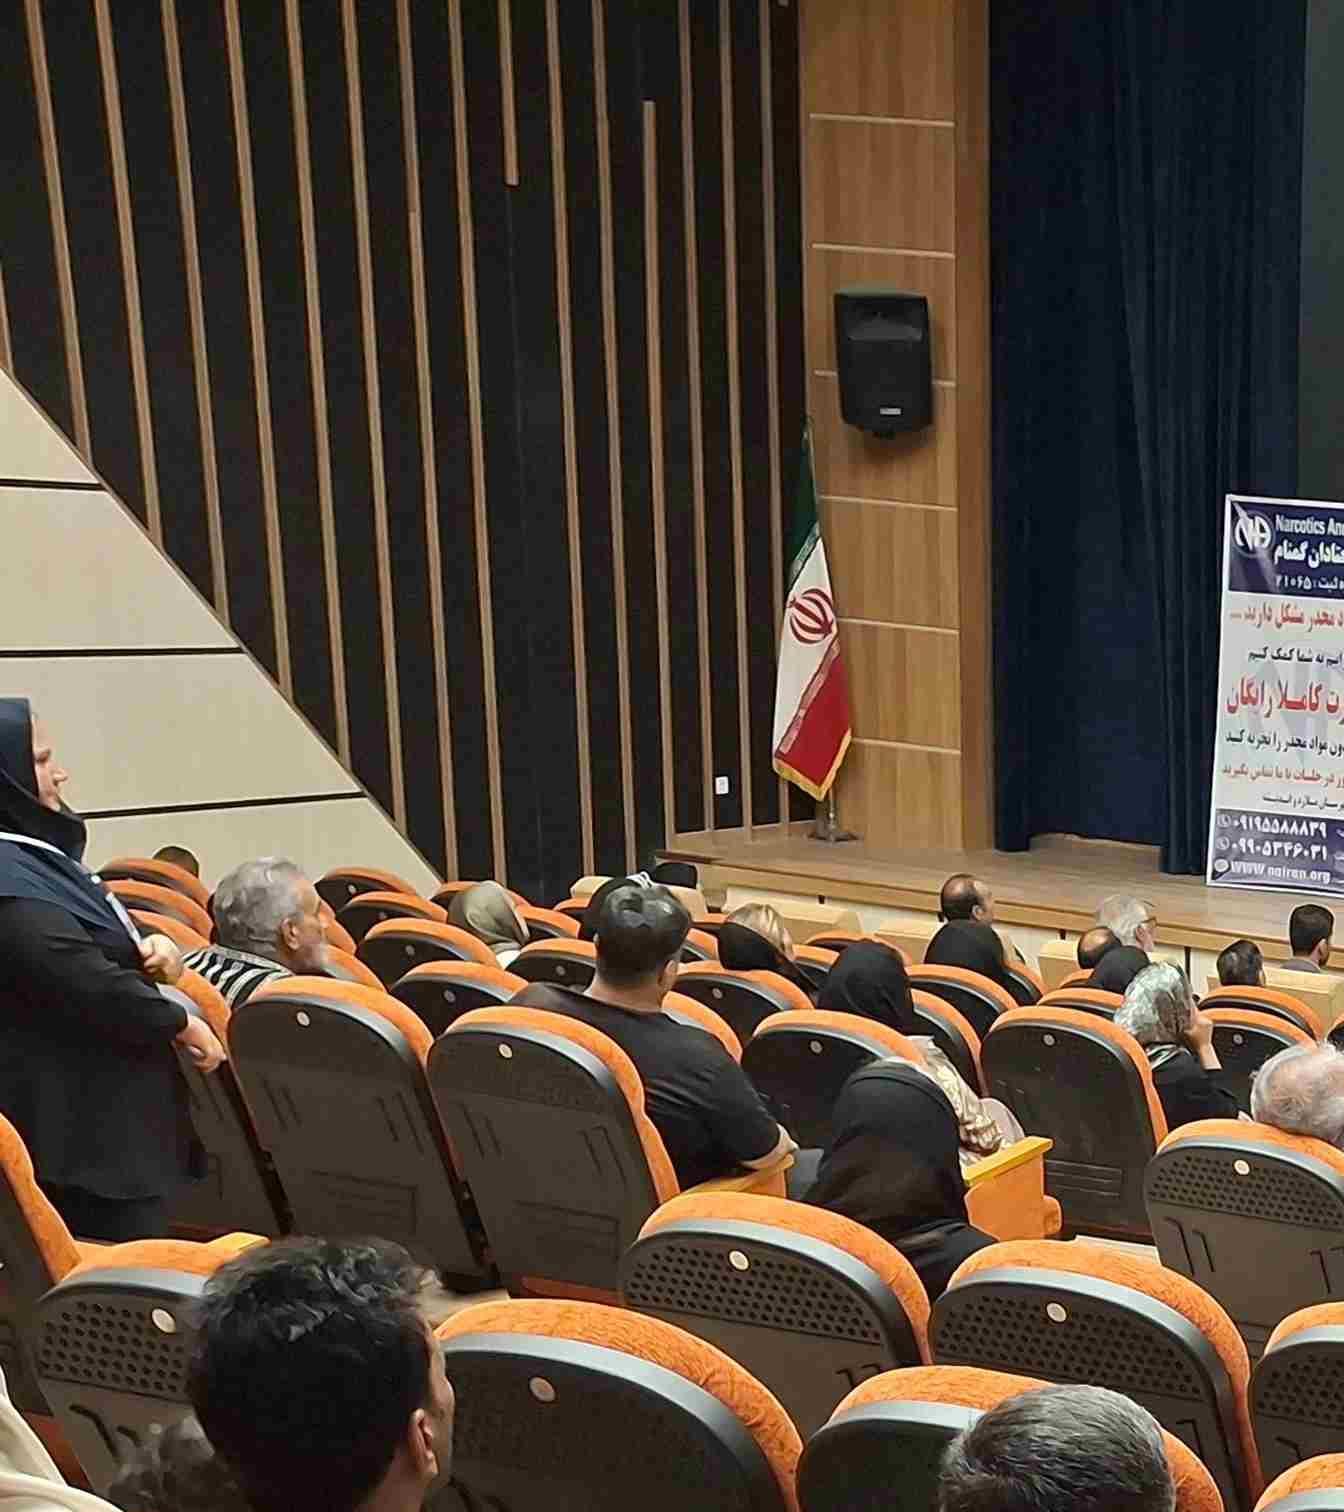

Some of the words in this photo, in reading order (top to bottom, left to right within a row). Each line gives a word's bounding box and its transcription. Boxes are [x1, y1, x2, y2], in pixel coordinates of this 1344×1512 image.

[1275, 514, 1326, 536] Narcotics
[1273, 538, 1309, 566] گمنام
[1275, 600, 1305, 629] مشکل
[1225, 675, 1273, 719] رایگان
[1284, 736, 1308, 753] مخدر
[1307, 734, 1329, 756] مواد
[1233, 814, 1328, 839] ۰۹۱۹۵۵۸۸۸۳۹
